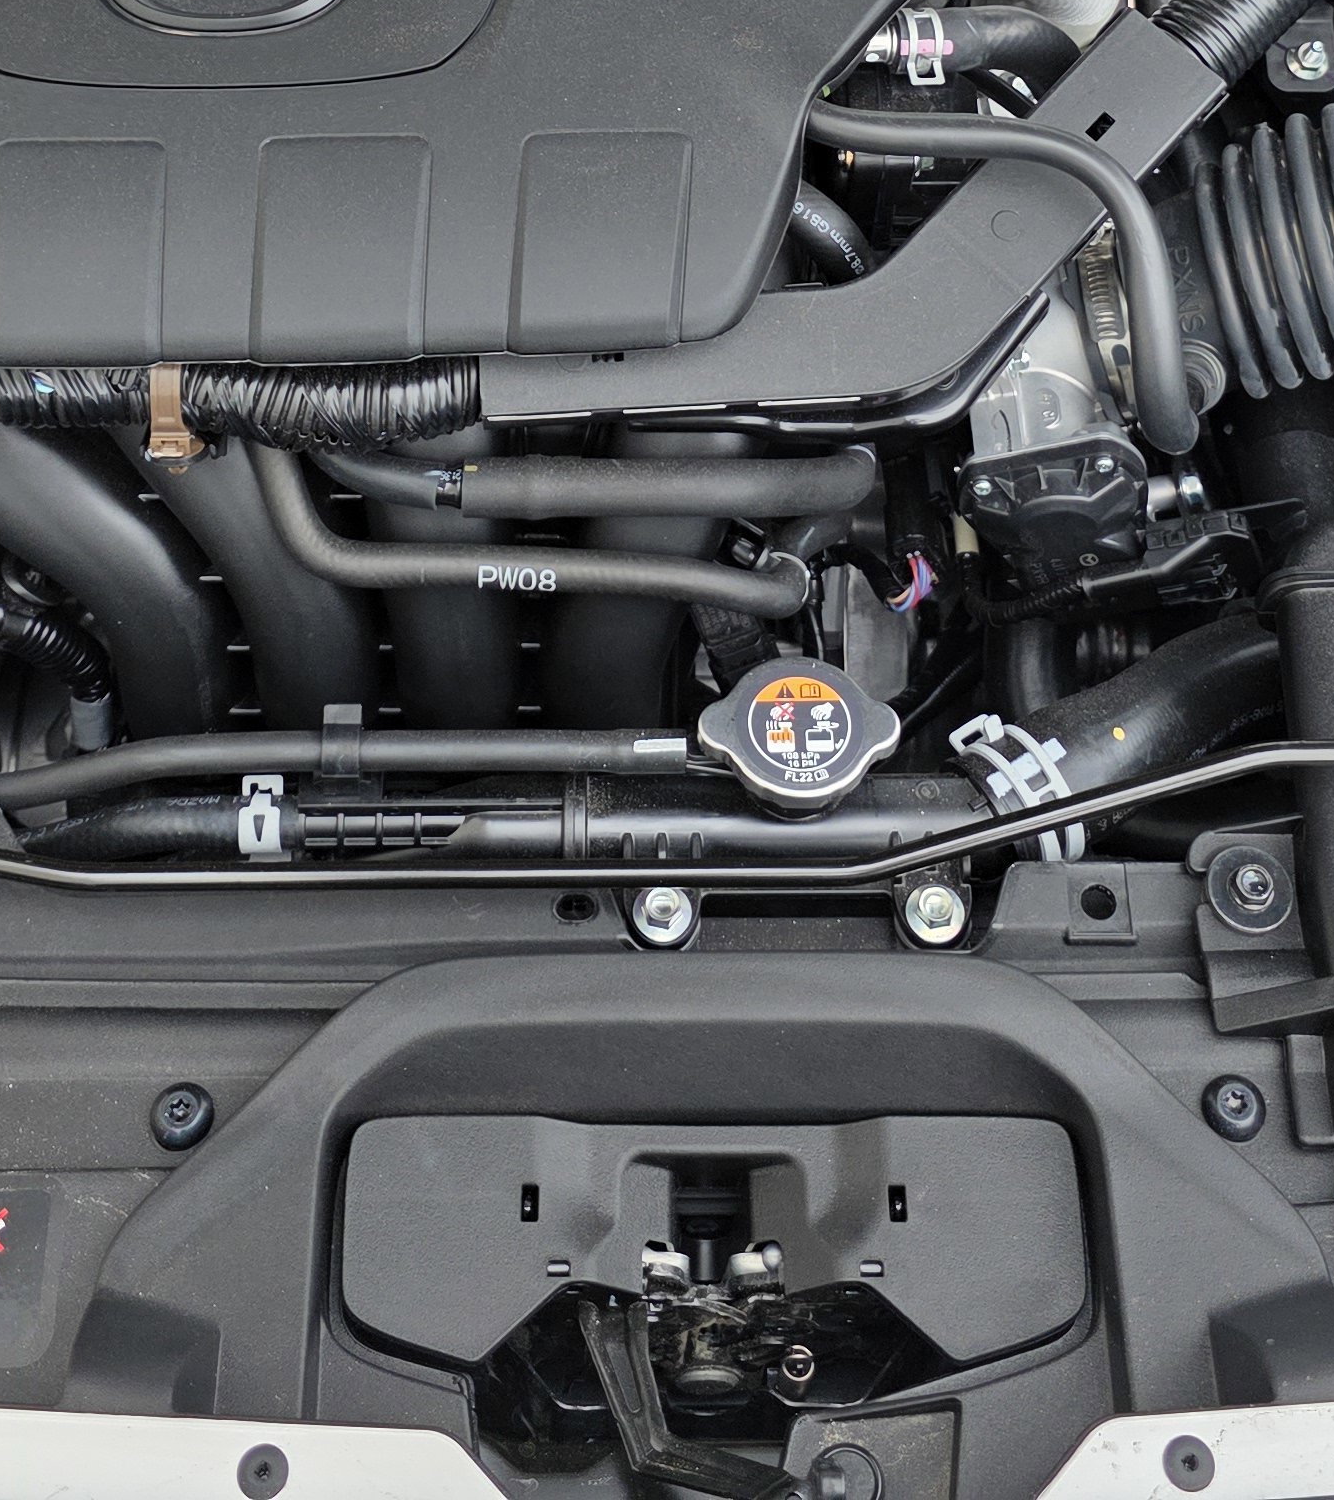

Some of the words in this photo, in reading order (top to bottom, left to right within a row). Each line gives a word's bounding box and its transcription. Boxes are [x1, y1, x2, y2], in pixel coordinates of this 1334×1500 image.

[478, 565, 557, 592] PW08
[781, 752, 799, 760] 108
[801, 751, 820, 761] kPa
[784, 770, 814, 782] FL22
